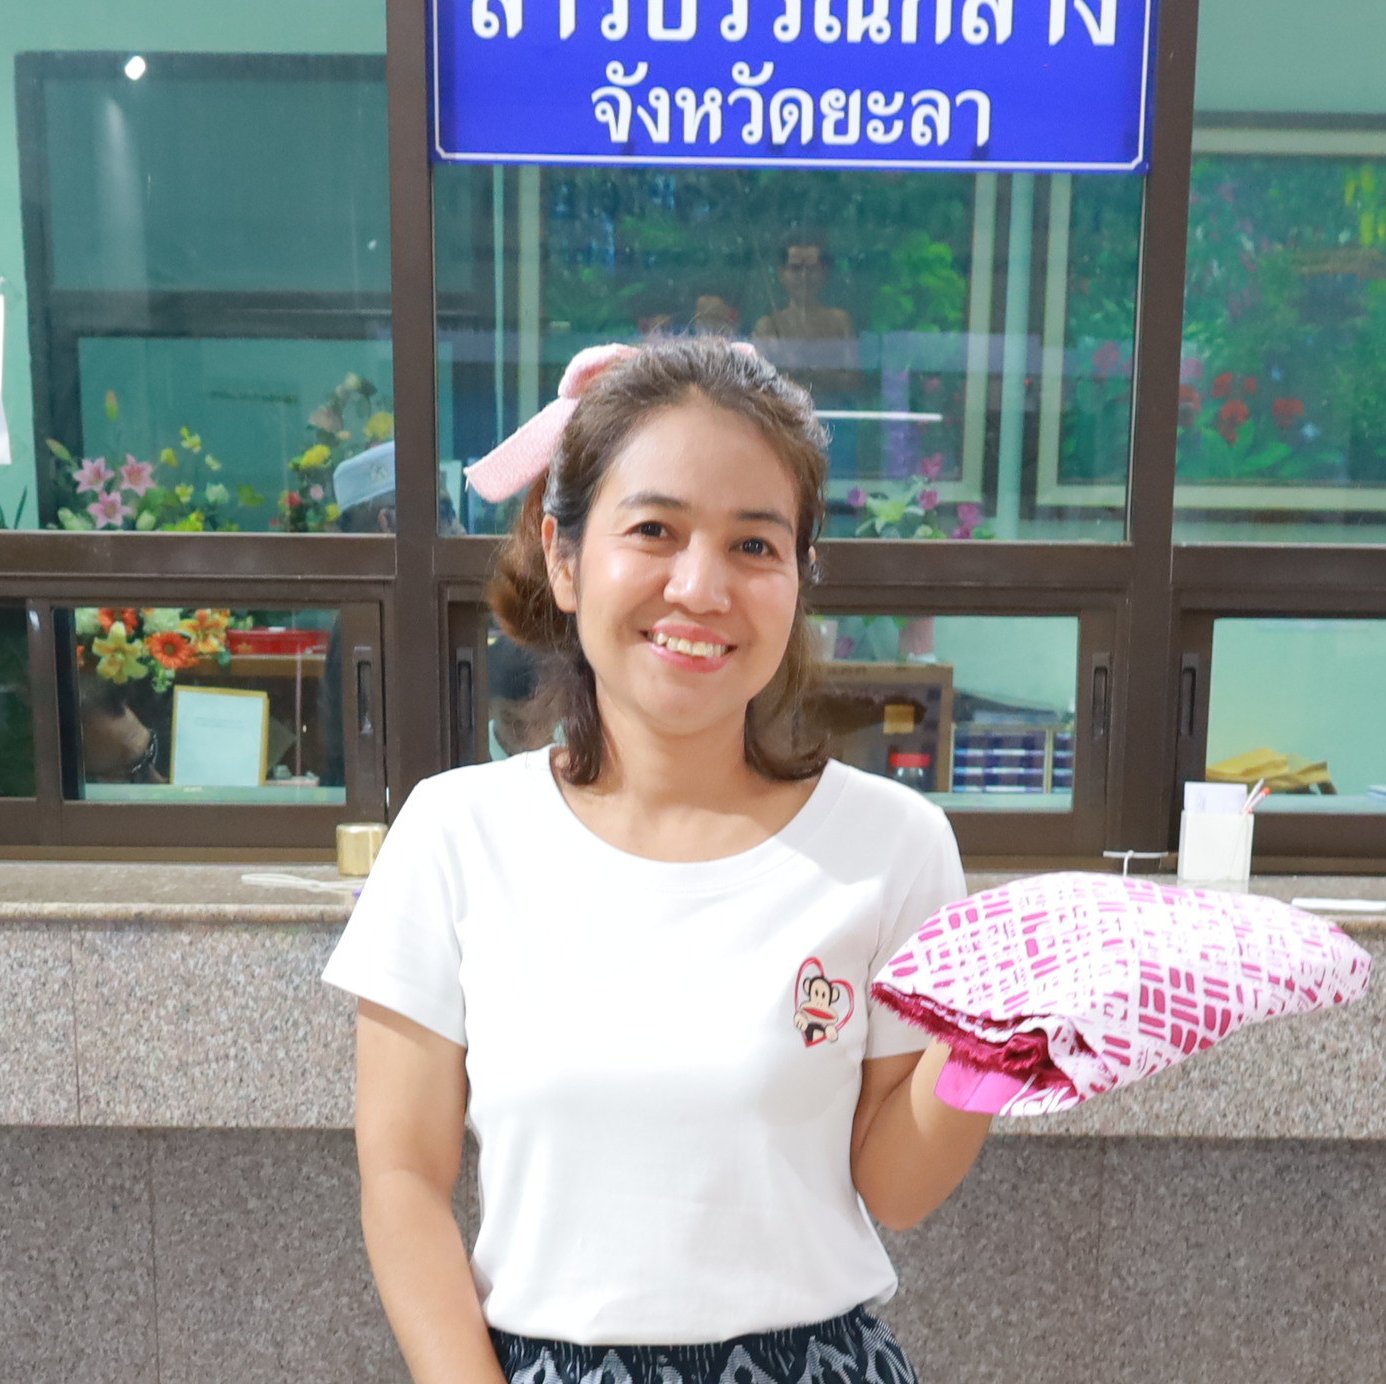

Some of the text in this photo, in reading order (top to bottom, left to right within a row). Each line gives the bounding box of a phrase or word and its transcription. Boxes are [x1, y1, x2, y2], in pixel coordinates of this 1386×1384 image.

[591, 60, 991, 147] จังหวัดยะลา
